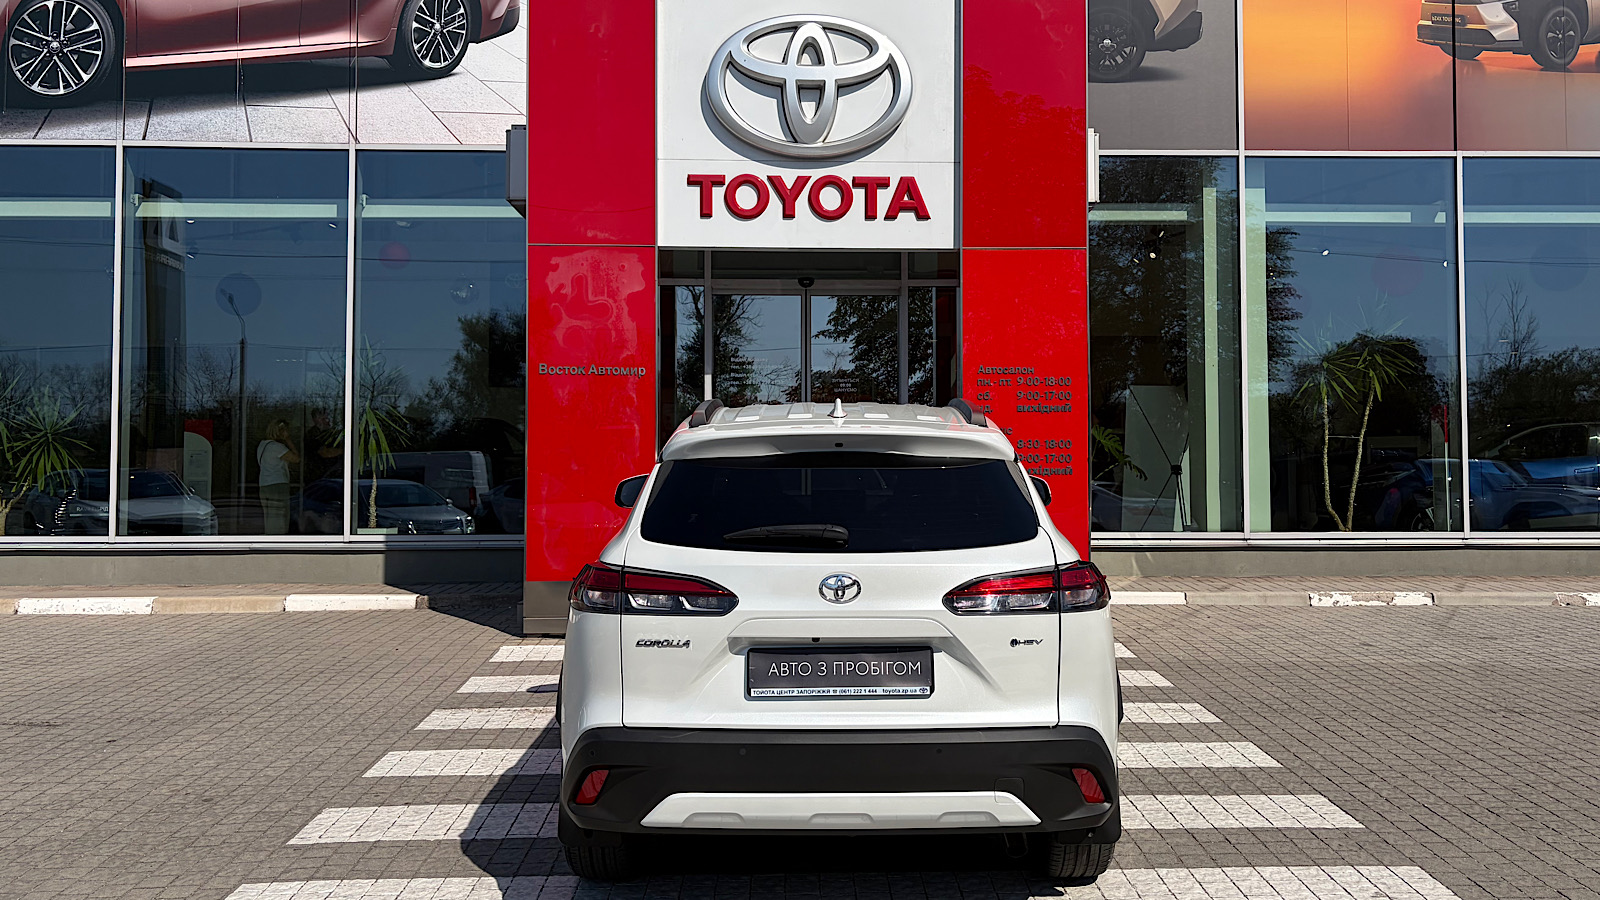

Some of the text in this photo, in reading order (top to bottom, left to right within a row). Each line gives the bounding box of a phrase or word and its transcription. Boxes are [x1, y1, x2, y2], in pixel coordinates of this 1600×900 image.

[687, 173, 931, 222] TOYOTA
[539, 363, 646, 379] Восток Автомир
[977, 365, 1035, 375] Автосалон
[1016, 376, 1072, 387] 9:00-18:00
[977, 391, 1072, 401] сб. 9:00-17:00
[1016, 403, 1072, 414] вихідний
[1017, 439, 1073, 449] 8:30-18:00
[1018, 453, 1073, 464] 9:00-17:00
[1027, 465, 1073, 477] хідний
[635, 639, 691, 649] COROLLA
[768, 662, 812, 677] АВТО
[833, 661, 921, 676] ПРОБІГОМ
